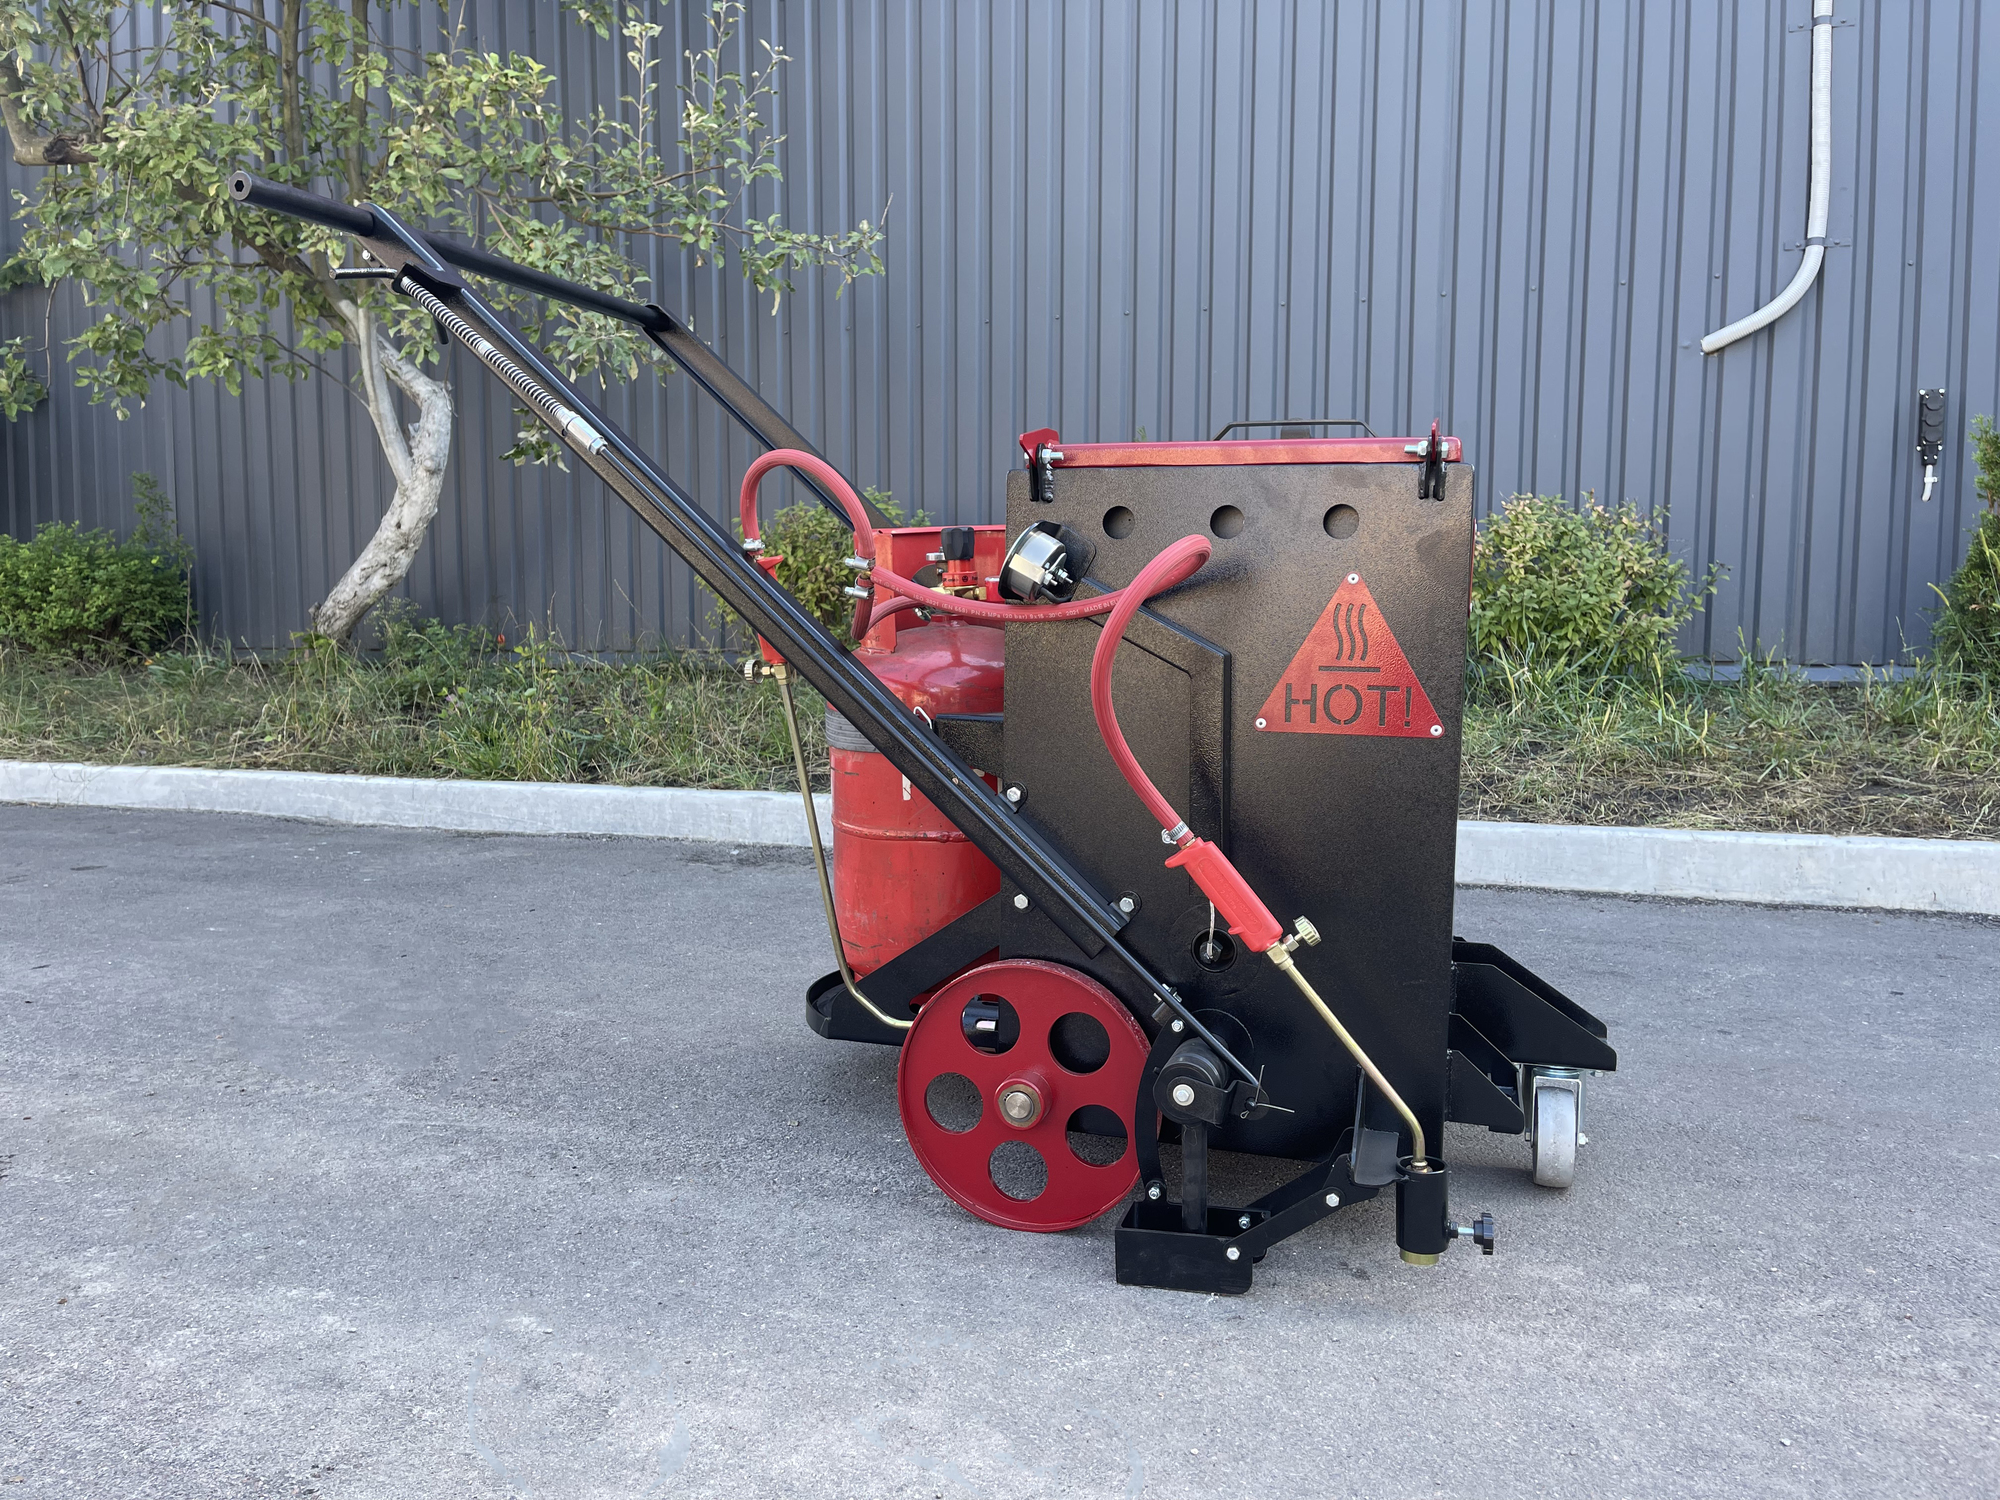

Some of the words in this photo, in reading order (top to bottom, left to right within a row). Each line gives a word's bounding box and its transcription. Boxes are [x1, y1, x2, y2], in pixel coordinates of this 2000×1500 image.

[913, 593, 924, 602] ISO
[941, 603, 953, 611] (EN
[1083, 603, 1103, 613] MADE
[1284, 682, 1412, 728] HOT!
